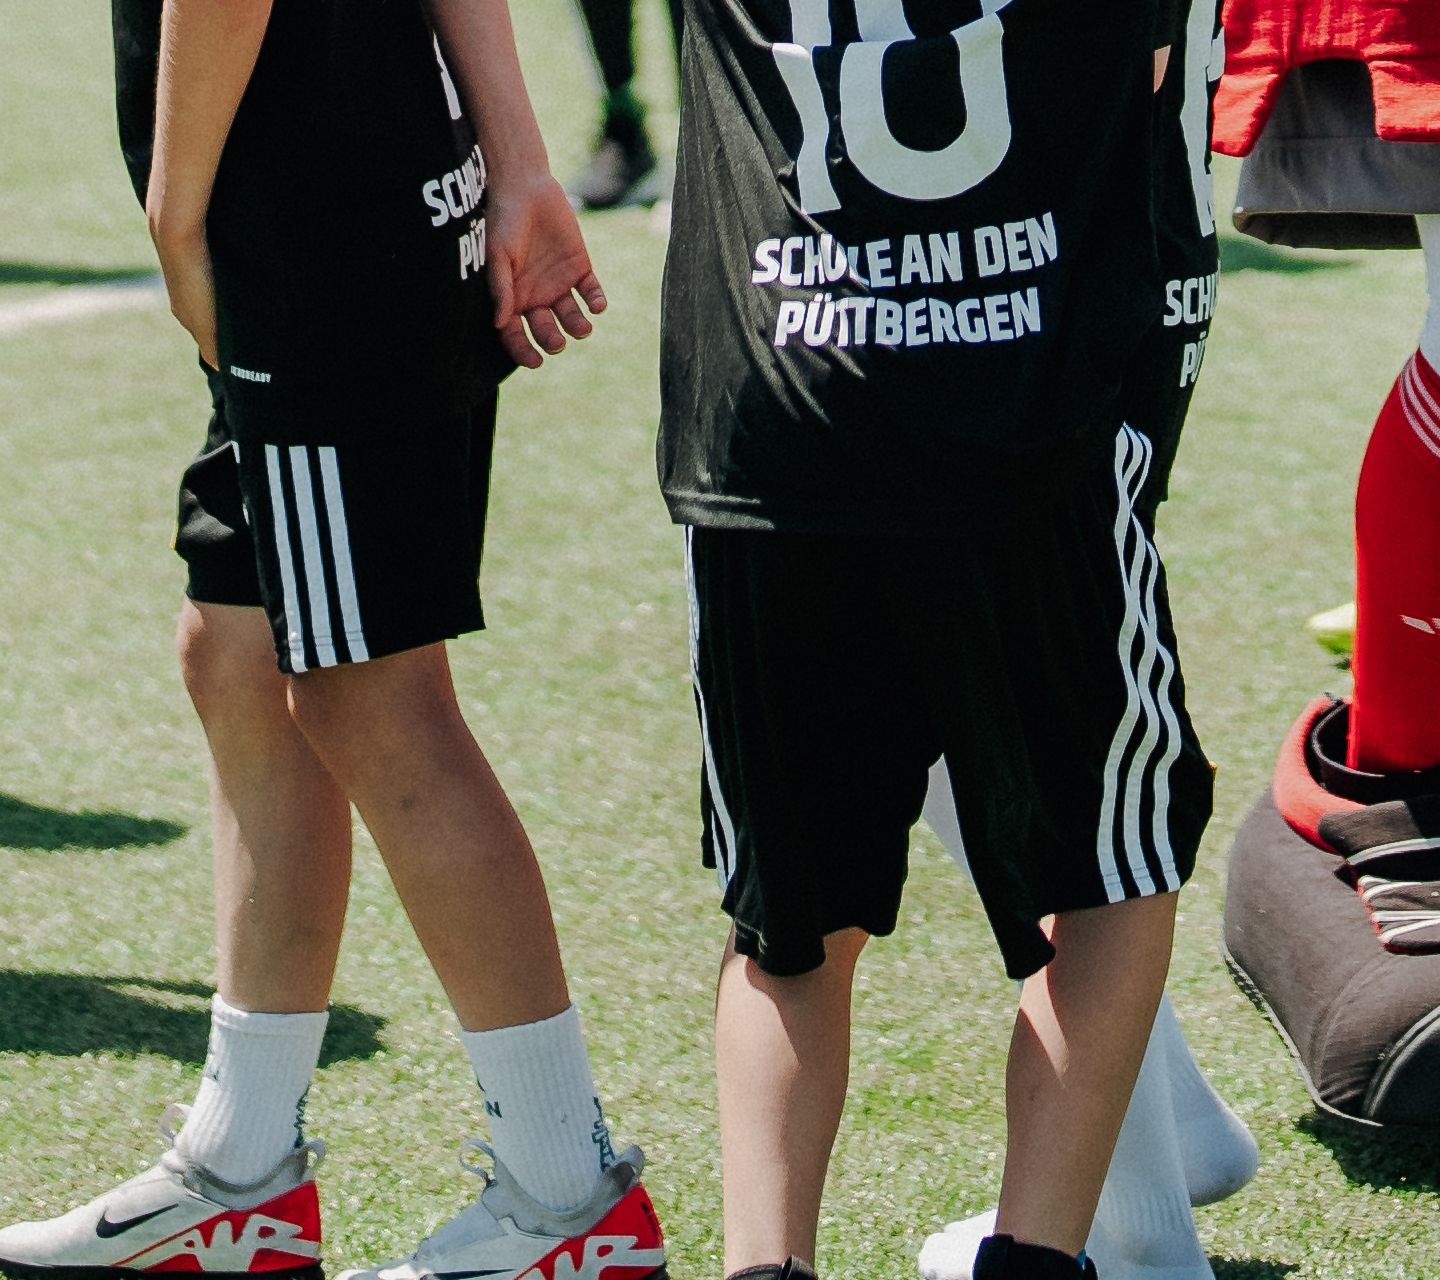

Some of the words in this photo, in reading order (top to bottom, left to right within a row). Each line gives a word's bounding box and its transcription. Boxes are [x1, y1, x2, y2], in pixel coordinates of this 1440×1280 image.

[751, 233, 896, 289] SCHULE
[900, 231, 964, 285] AN
[973, 211, 1059, 279] DEN
[773, 286, 1042, 349] PÜTTBERGEN
